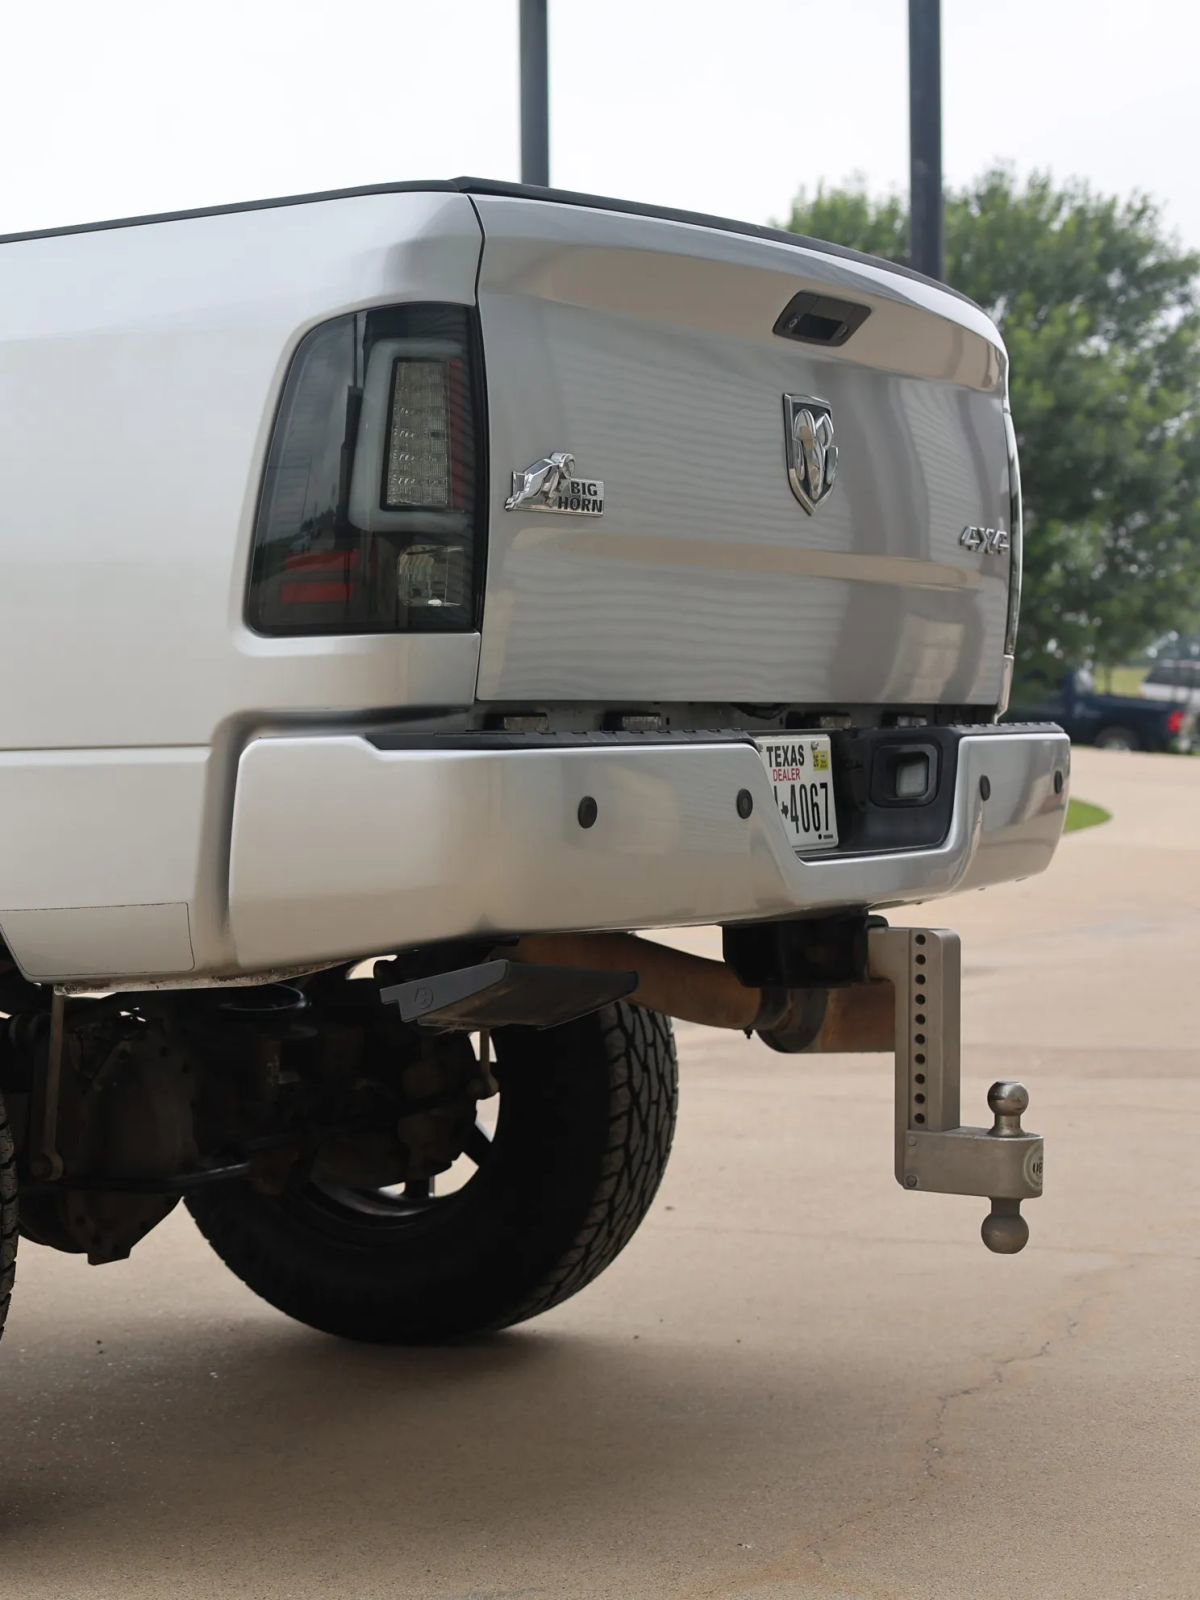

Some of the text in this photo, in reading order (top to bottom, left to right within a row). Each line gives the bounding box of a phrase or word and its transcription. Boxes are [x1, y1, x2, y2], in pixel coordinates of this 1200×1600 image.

[570, 481, 598, 497] BIG
[557, 496, 603, 513] HORN
[766, 744, 805, 768] TEXAS
[772, 768, 801, 782] DEALER
